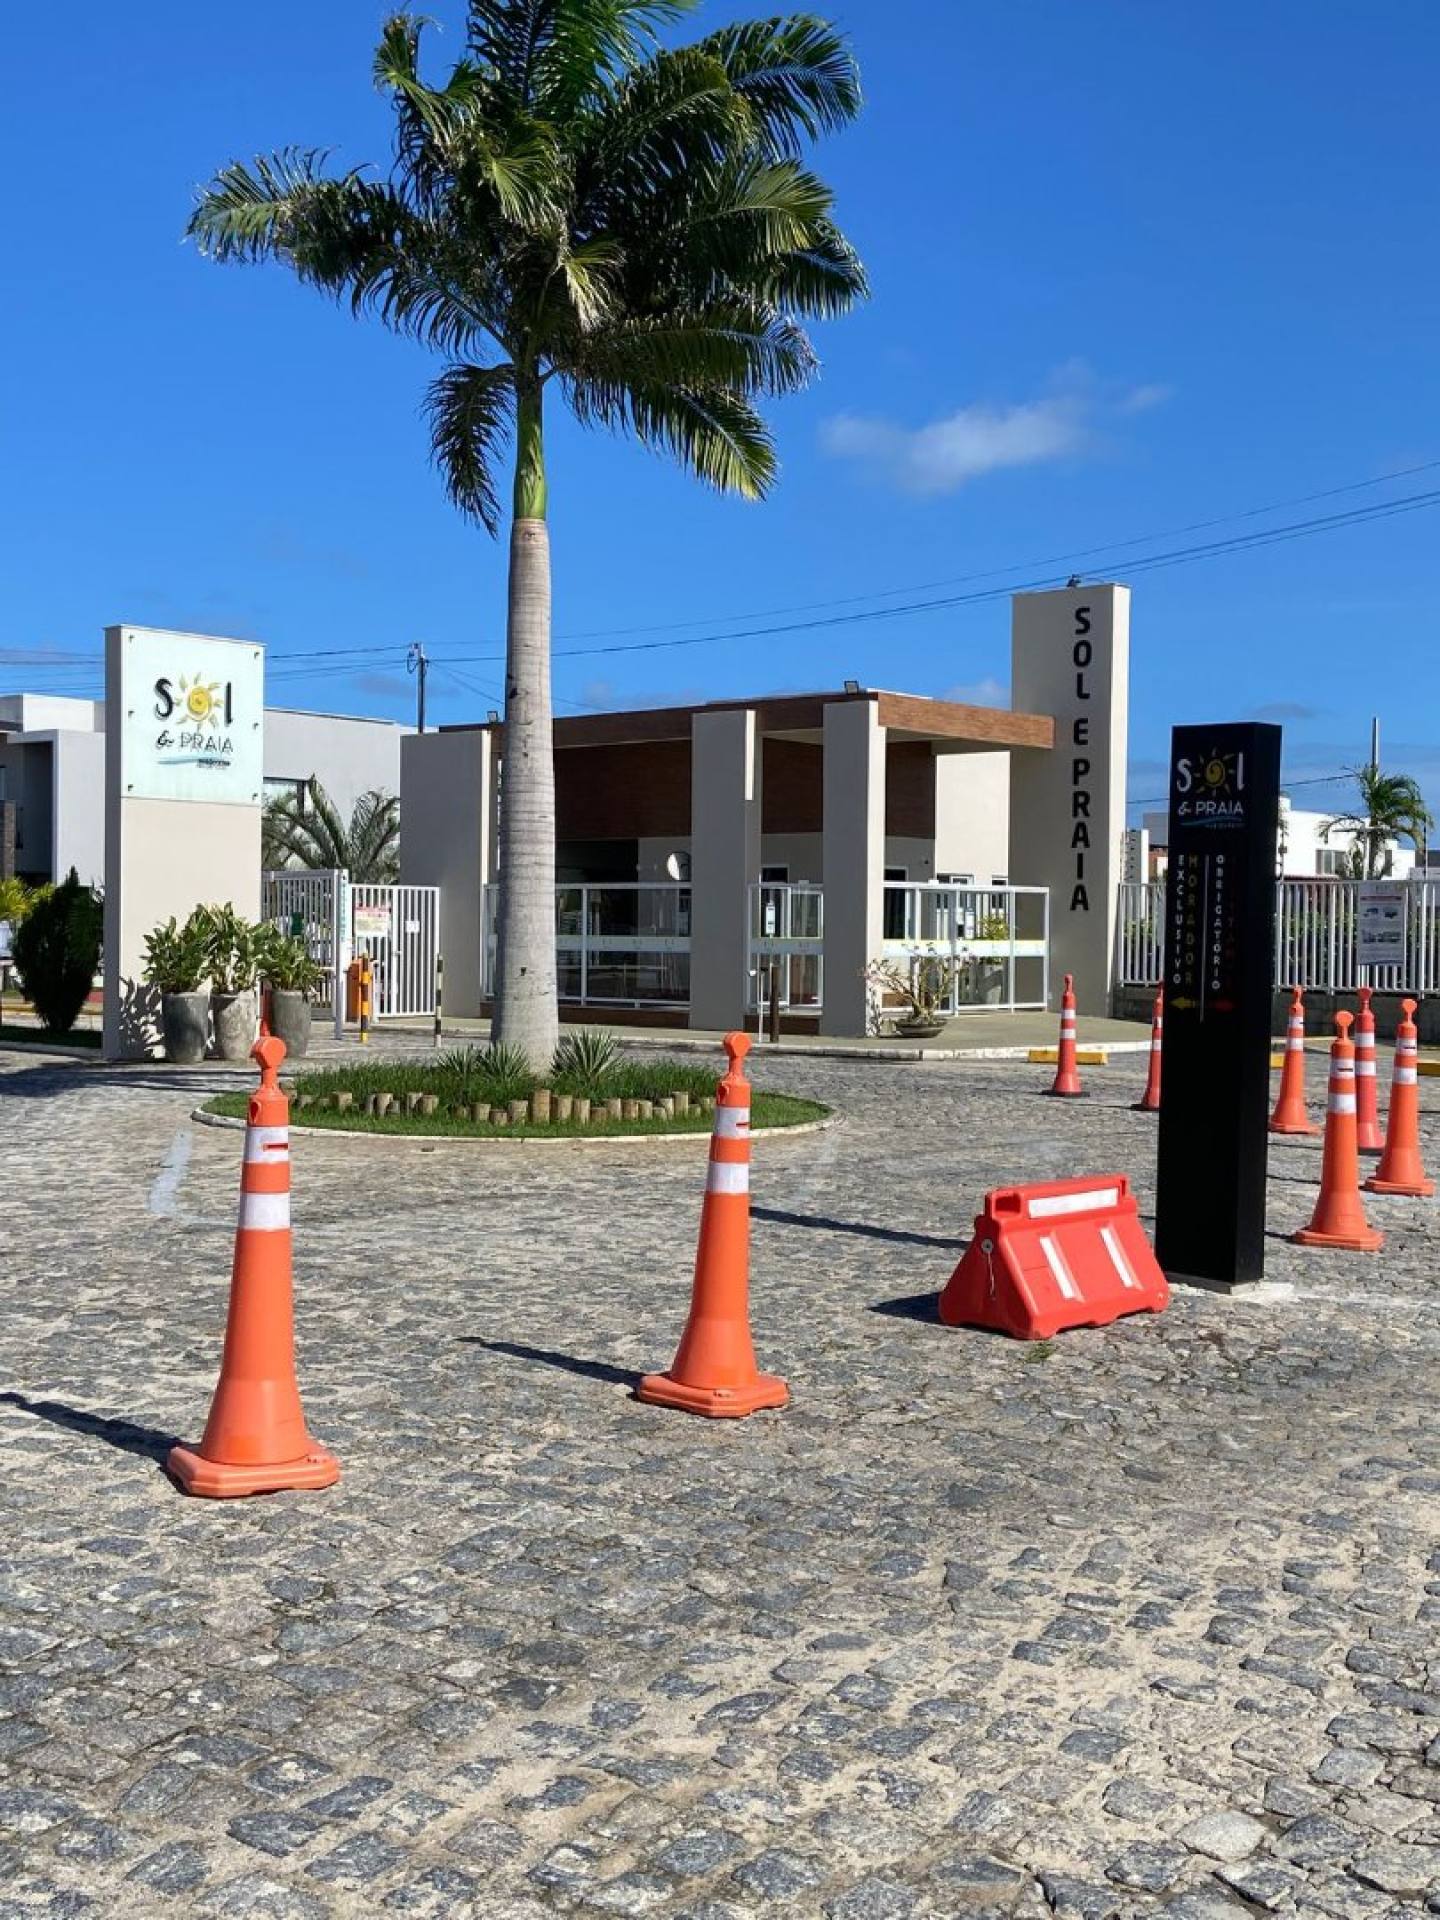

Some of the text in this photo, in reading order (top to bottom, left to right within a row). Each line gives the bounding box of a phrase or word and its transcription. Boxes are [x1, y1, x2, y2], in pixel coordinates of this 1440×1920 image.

[180, 731, 234, 753] PRAIA
[1070, 606, 1092, 911] SOL E PRAIA
[1195, 800, 1244, 816] PRAIA
